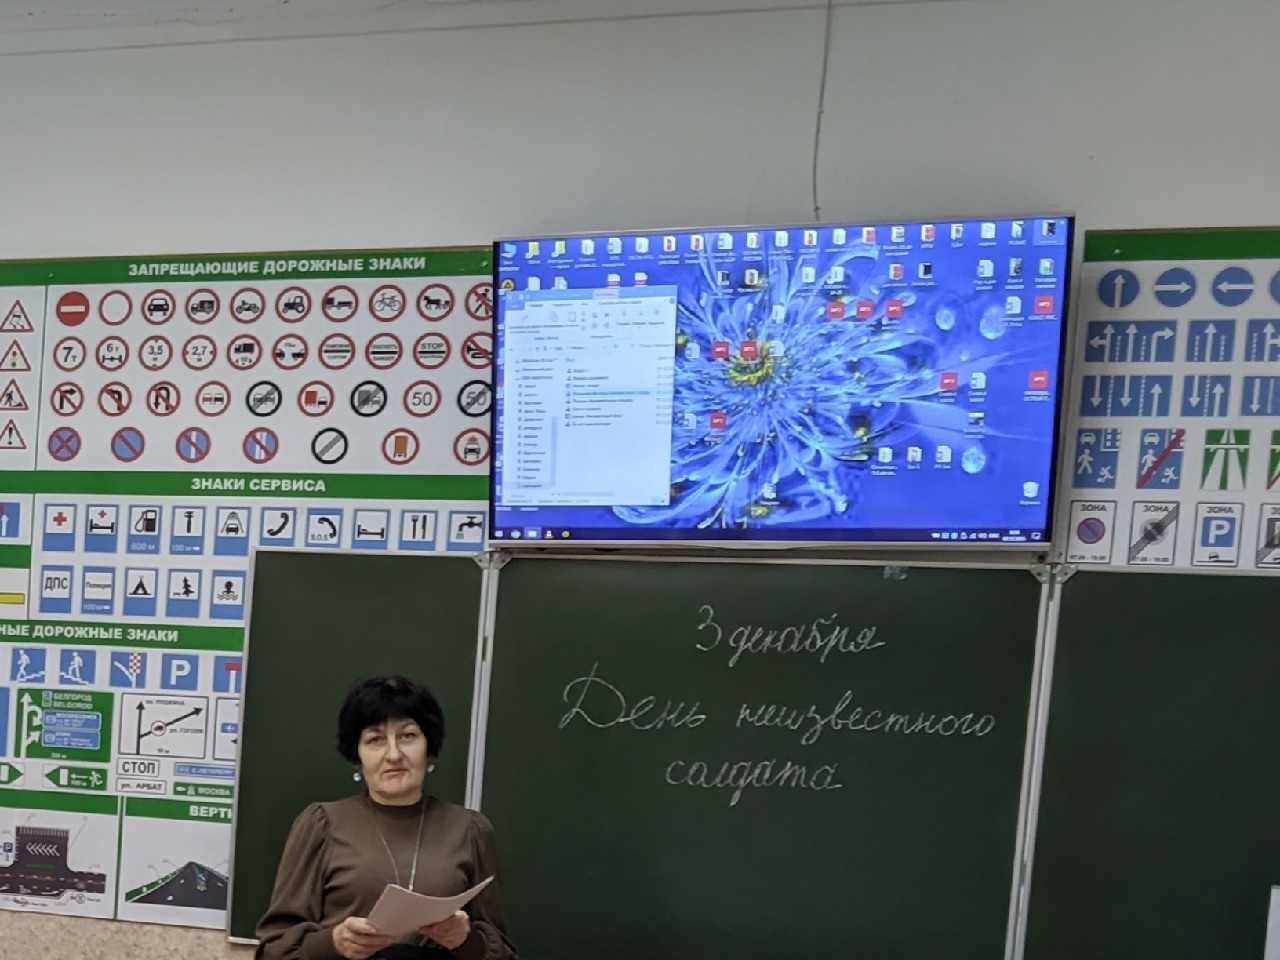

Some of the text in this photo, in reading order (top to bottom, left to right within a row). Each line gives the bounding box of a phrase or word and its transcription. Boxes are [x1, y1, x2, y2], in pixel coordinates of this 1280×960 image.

[128, 256, 426, 277] ЗАПРЕЩАЮЩИЕ ДОРОЖНЫЕ ЗНАКИ
[420, 342, 444, 350] STOP
[412, 391, 433, 407] 50
[191, 477, 326, 492] ЗНАКИ СЕРВИСА
[1208, 519, 1231, 544] P
[44, 576, 68, 591] ДПС
[32, 625, 123, 640] ДОРОЖНЫЕ
[126, 628, 179, 643] ЗНАКИ
[695, 604, 886, 668] 3 декабря
[170, 660, 191, 686] P
[558, 662, 995, 746] День неизвестного
[121, 761, 156, 774] СТОП
